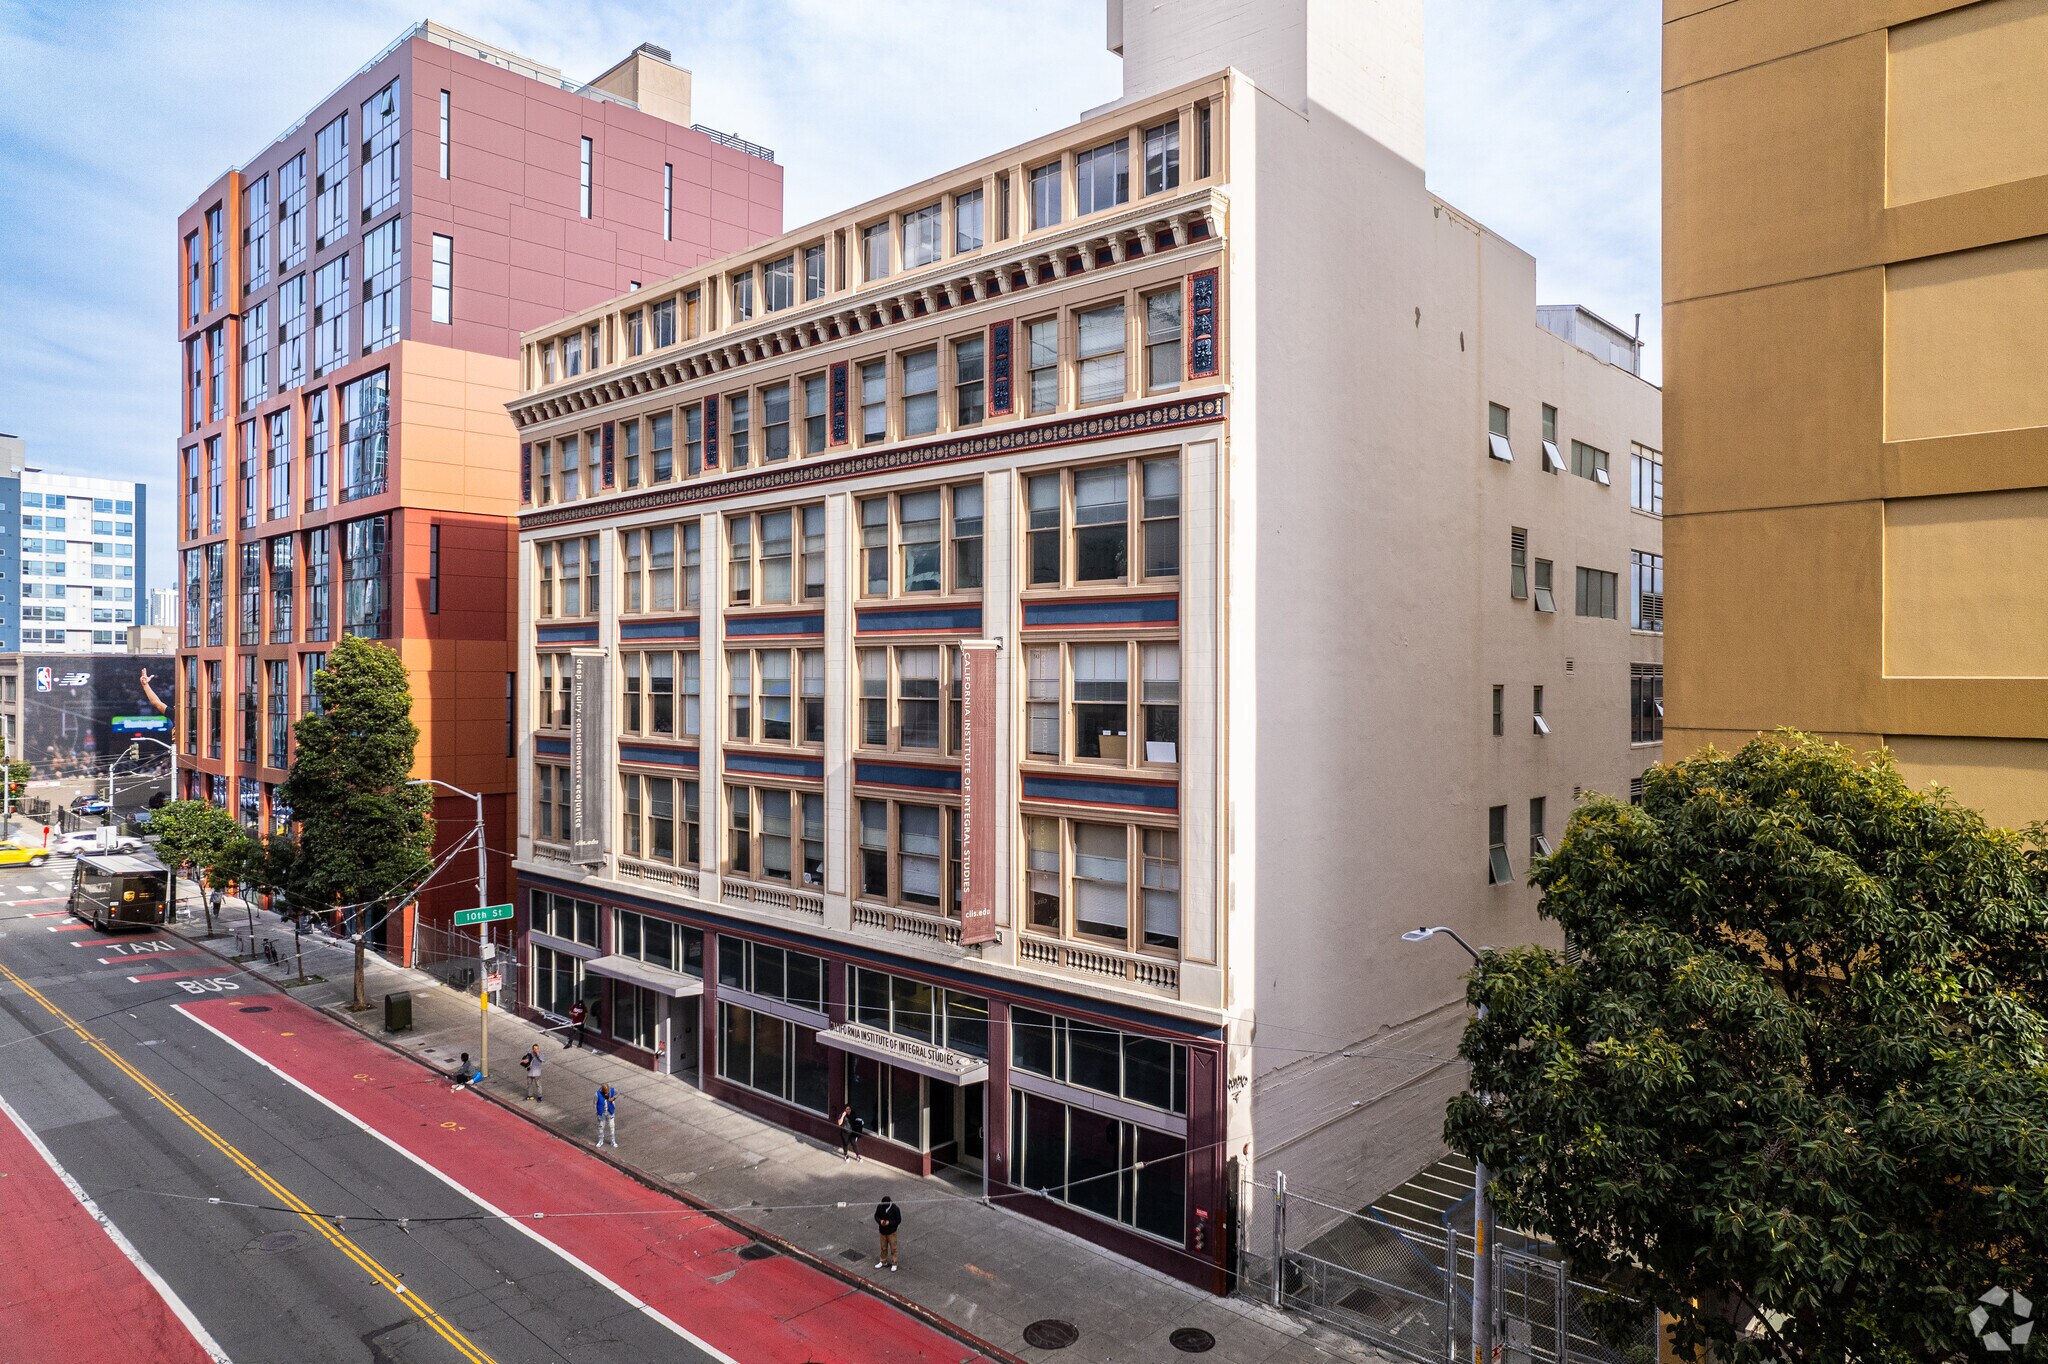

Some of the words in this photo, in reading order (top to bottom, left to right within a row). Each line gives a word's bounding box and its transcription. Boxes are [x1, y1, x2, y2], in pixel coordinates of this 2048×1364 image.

[575, 658, 583, 680] deep
[575, 683, 583, 712] inquiry
[964, 777, 971, 792] OF
[963, 794, 971, 847] INTEGRAL
[963, 849, 971, 893] STUDIES
[467, 911, 486, 921] 10th
[493, 909, 502, 917] St
[965, 907, 991, 919] ciis.edu
[105, 940, 177, 956] TAXI
[174, 977, 241, 995] BUS
[830, 1020, 861, 1039] CALIFORNIA
[861, 1030, 889, 1047] INSTITUTE
[890, 1039, 898, 1050] OF
[899, 1041, 927, 1059] INTEGRAL
[927, 1049, 954, 1066] STUDIES
